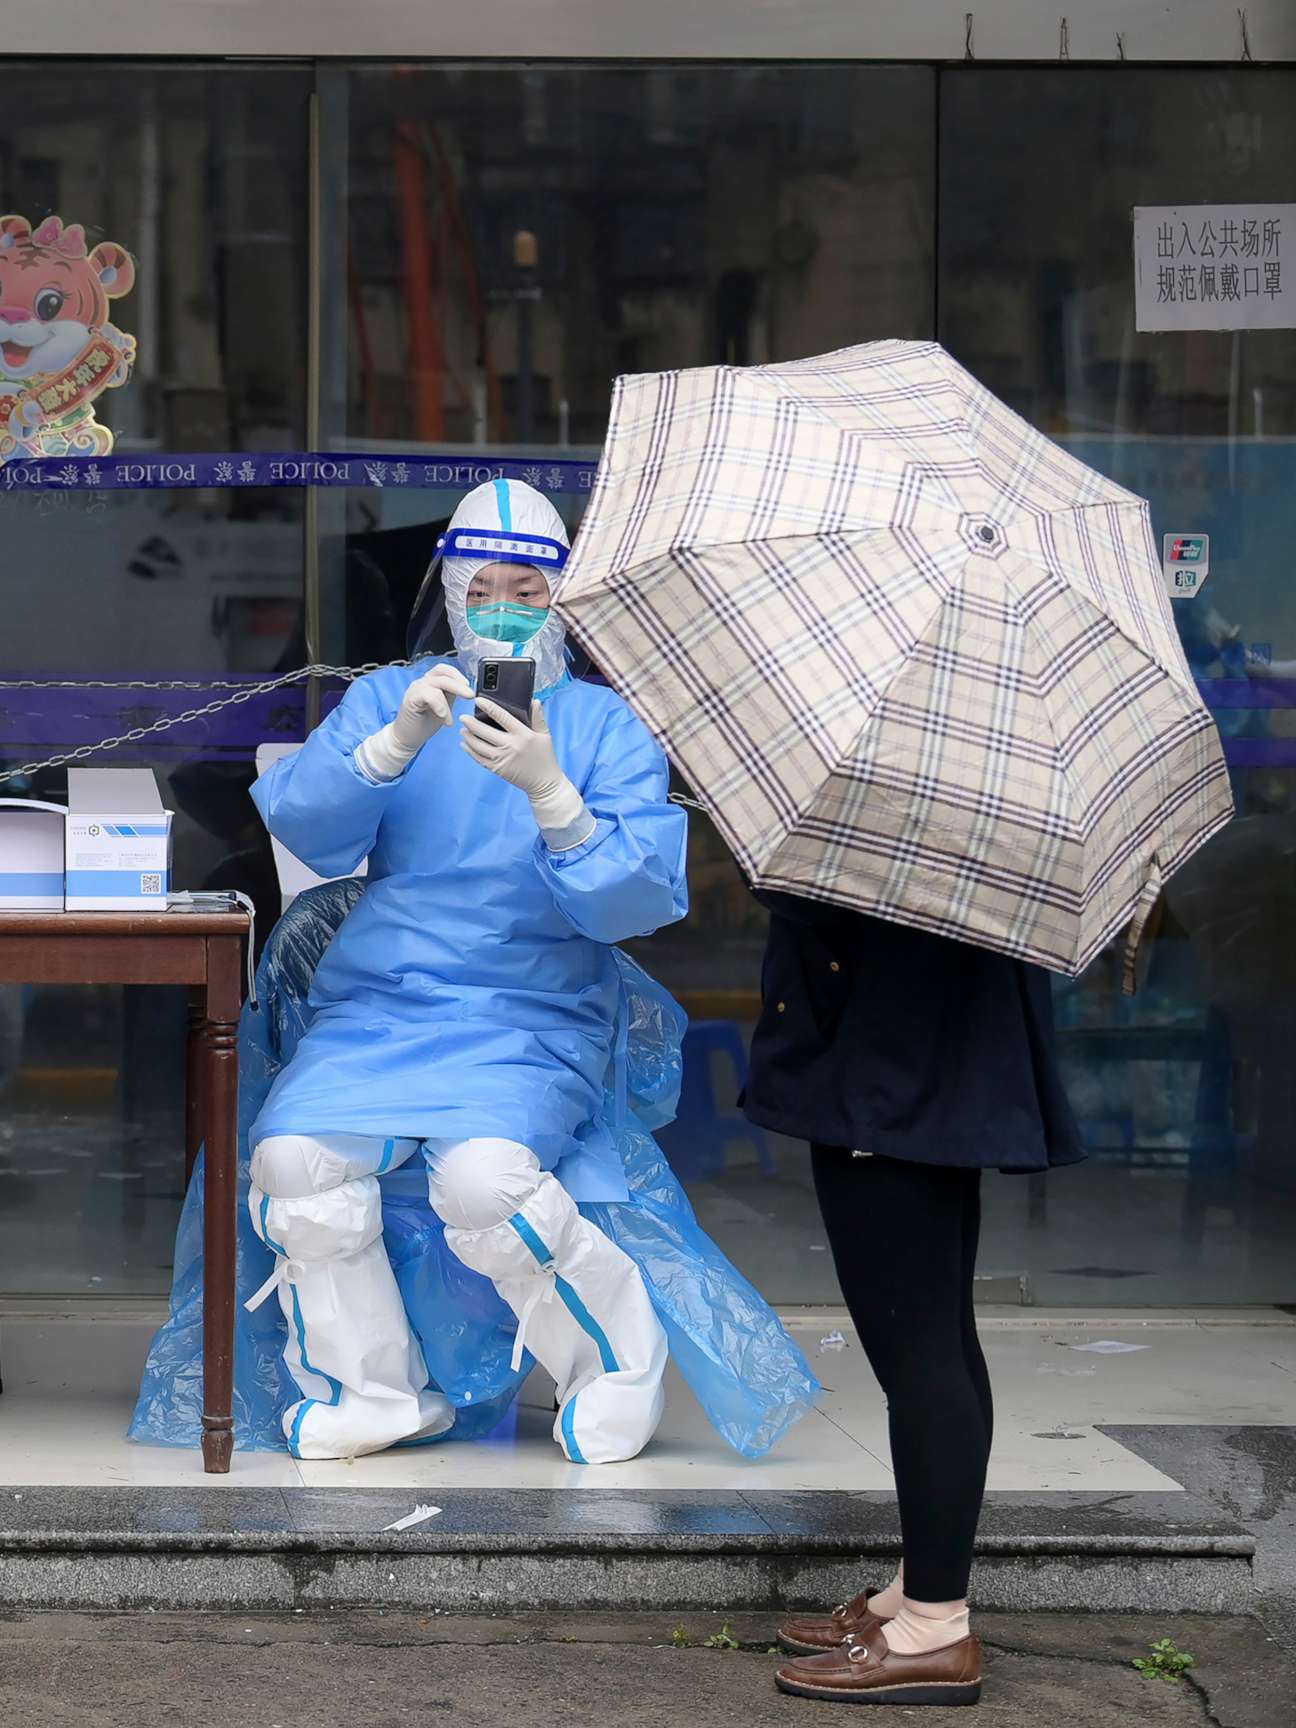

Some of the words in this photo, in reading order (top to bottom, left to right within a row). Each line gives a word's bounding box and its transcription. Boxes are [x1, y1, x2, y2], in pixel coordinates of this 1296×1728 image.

[1157, 218, 1281, 259] 出入公共场所
[1156, 262, 1282, 303] 规范佩戴口罩
[61, 463, 103, 485] 警察
[115, 464, 197, 482] POLICE
[214, 461, 256, 482] 警察
[270, 462, 351, 480] POLICE
[424, 465, 504, 484] POLICE
[522, 467, 566, 488] 警察
